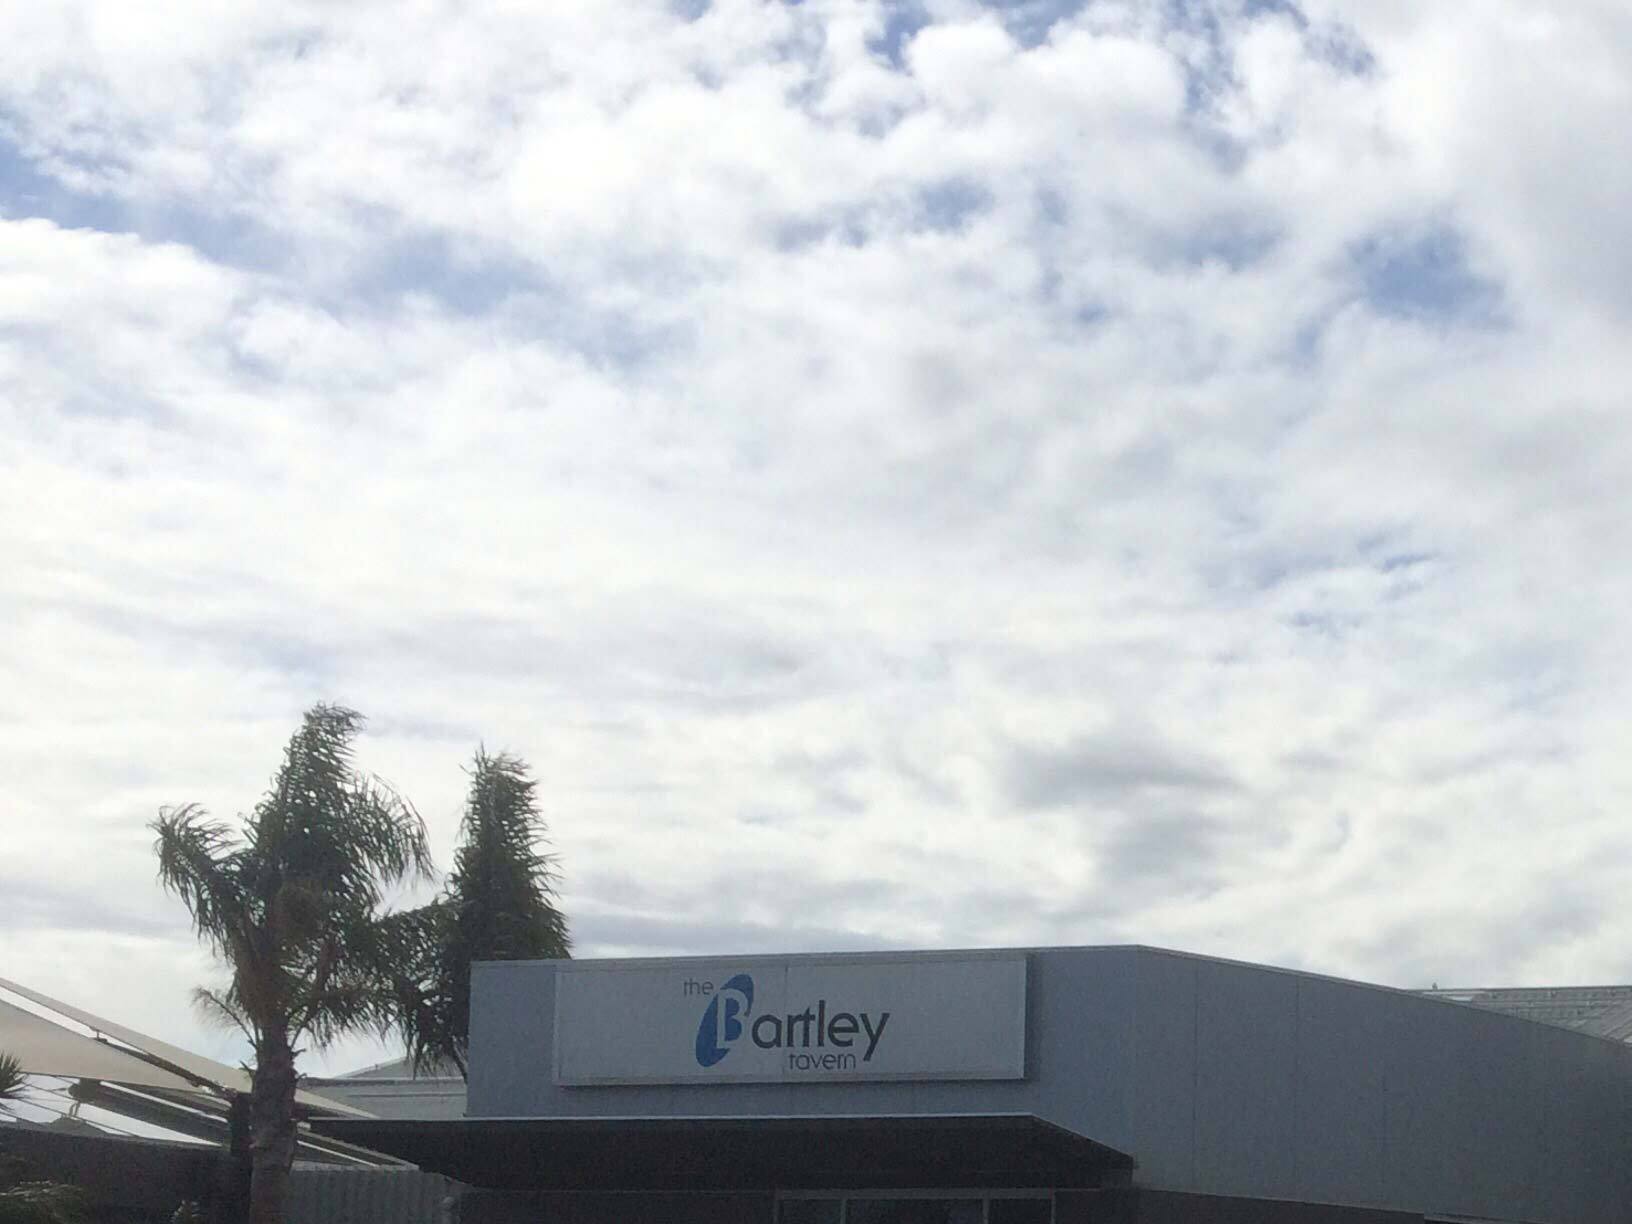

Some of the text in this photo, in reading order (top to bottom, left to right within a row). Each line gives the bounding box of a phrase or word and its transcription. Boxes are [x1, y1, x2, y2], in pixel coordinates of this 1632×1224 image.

[683, 978, 714, 996] the
[714, 985, 890, 1062] Bartley
[788, 1052, 857, 1070] tavern
